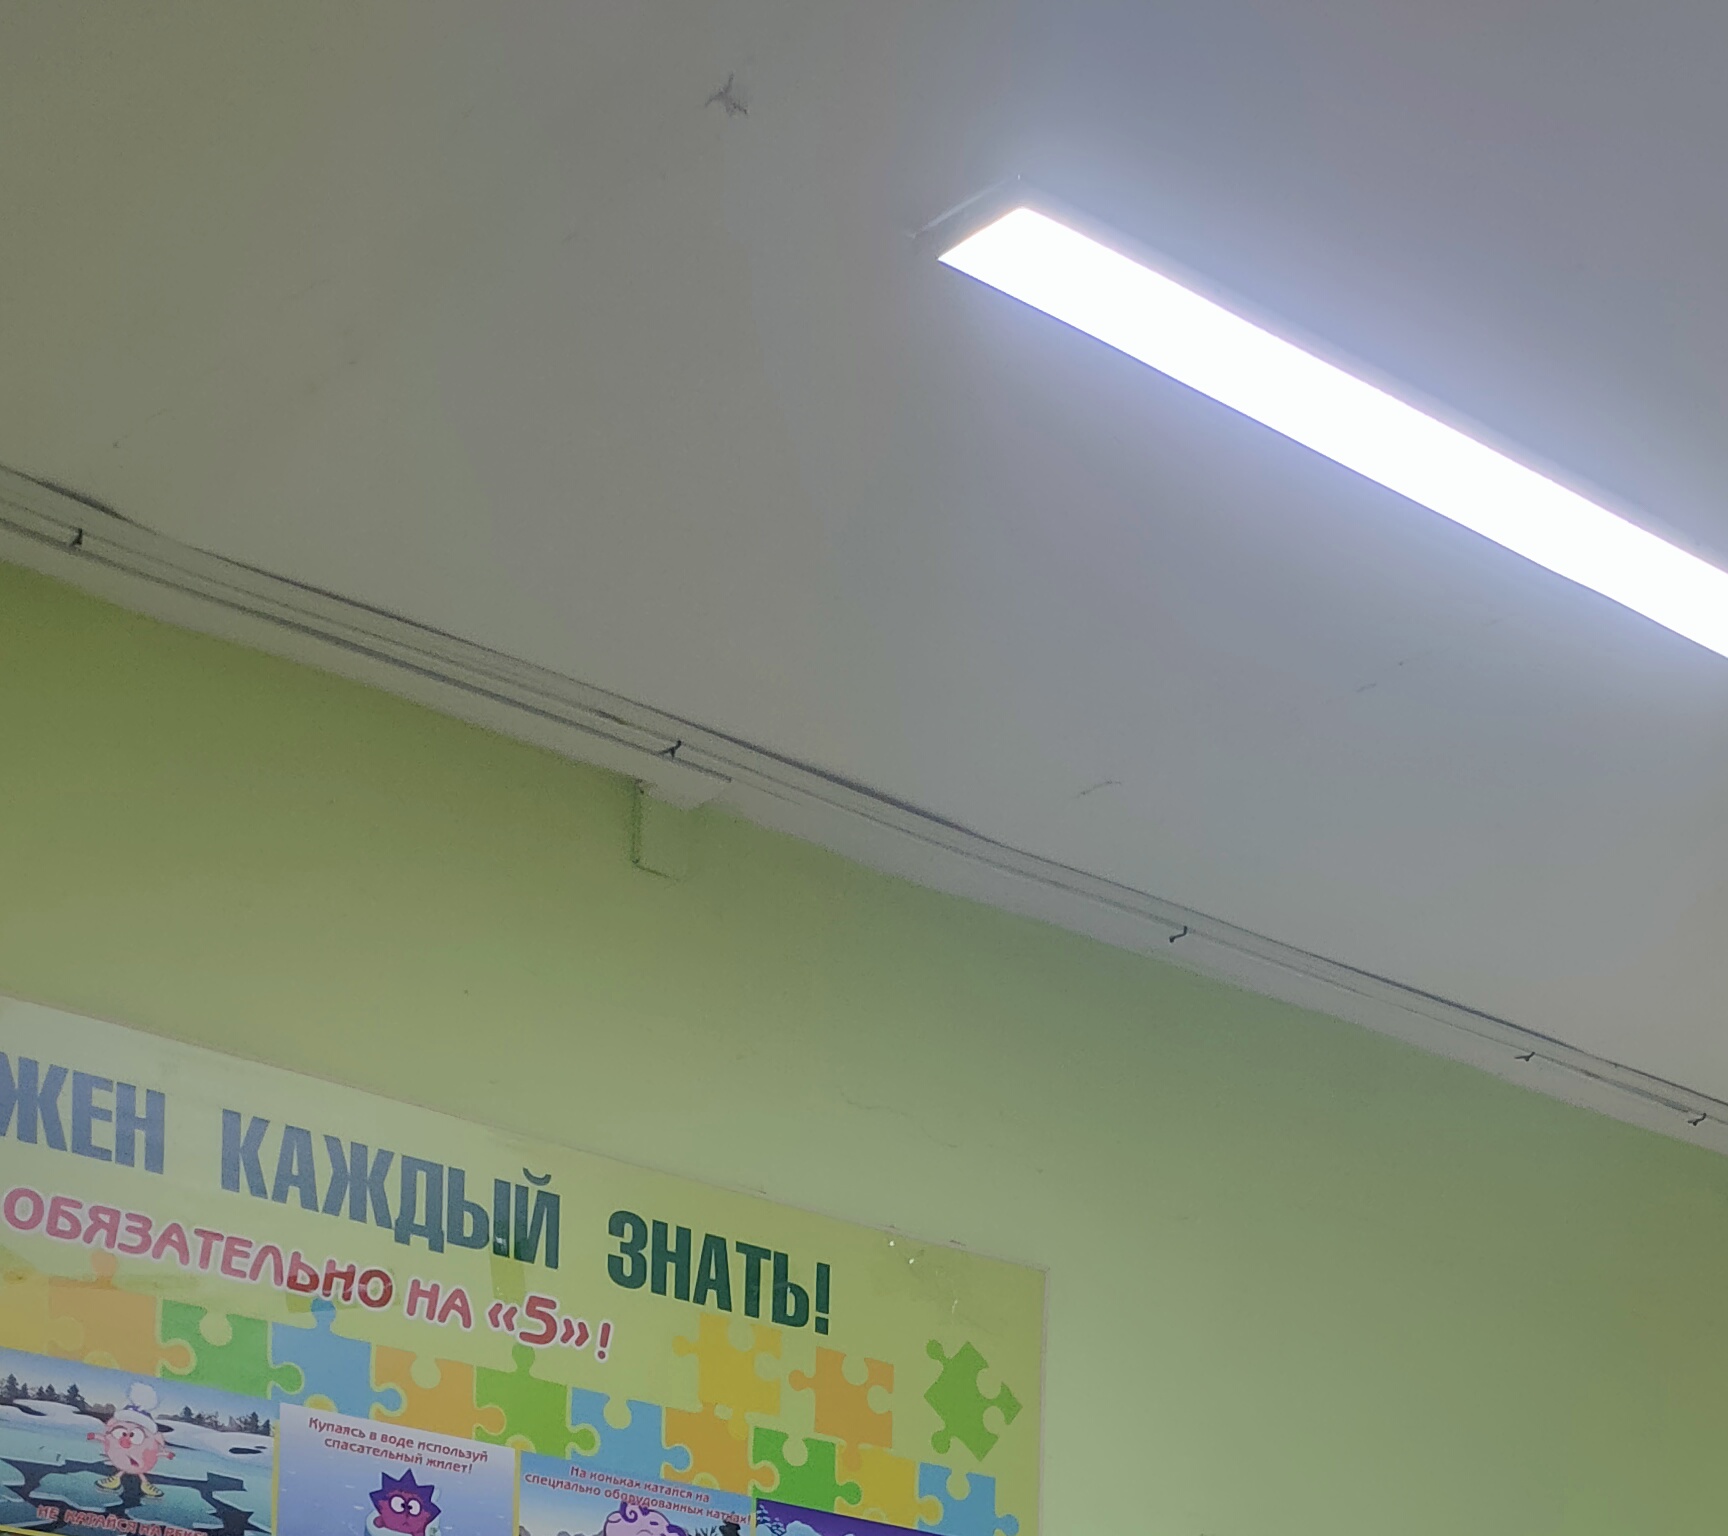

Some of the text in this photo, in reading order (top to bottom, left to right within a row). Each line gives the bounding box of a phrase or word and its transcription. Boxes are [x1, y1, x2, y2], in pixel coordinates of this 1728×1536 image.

[221, 1108, 560, 1270] КАЖДЫЙ
[607, 1210, 830, 1335] ЗНАТЬ!
[3, 1187, 393, 1308] ОБЯЗАТЕЛЬНО
[406, 1279, 472, 1329] НА
[308, 1417, 488, 1463] Купаясь в воде используй
[324, 1438, 473, 1474] спасательный жилет!
[524, 1473, 752, 1525] специально оборудованных катках!
[570, 1466, 710, 1503] На коньках катайся на
[36, 1505, 59, 1521] НЕ
[64, 1509, 137, 1534] КАТАЙСЯ
